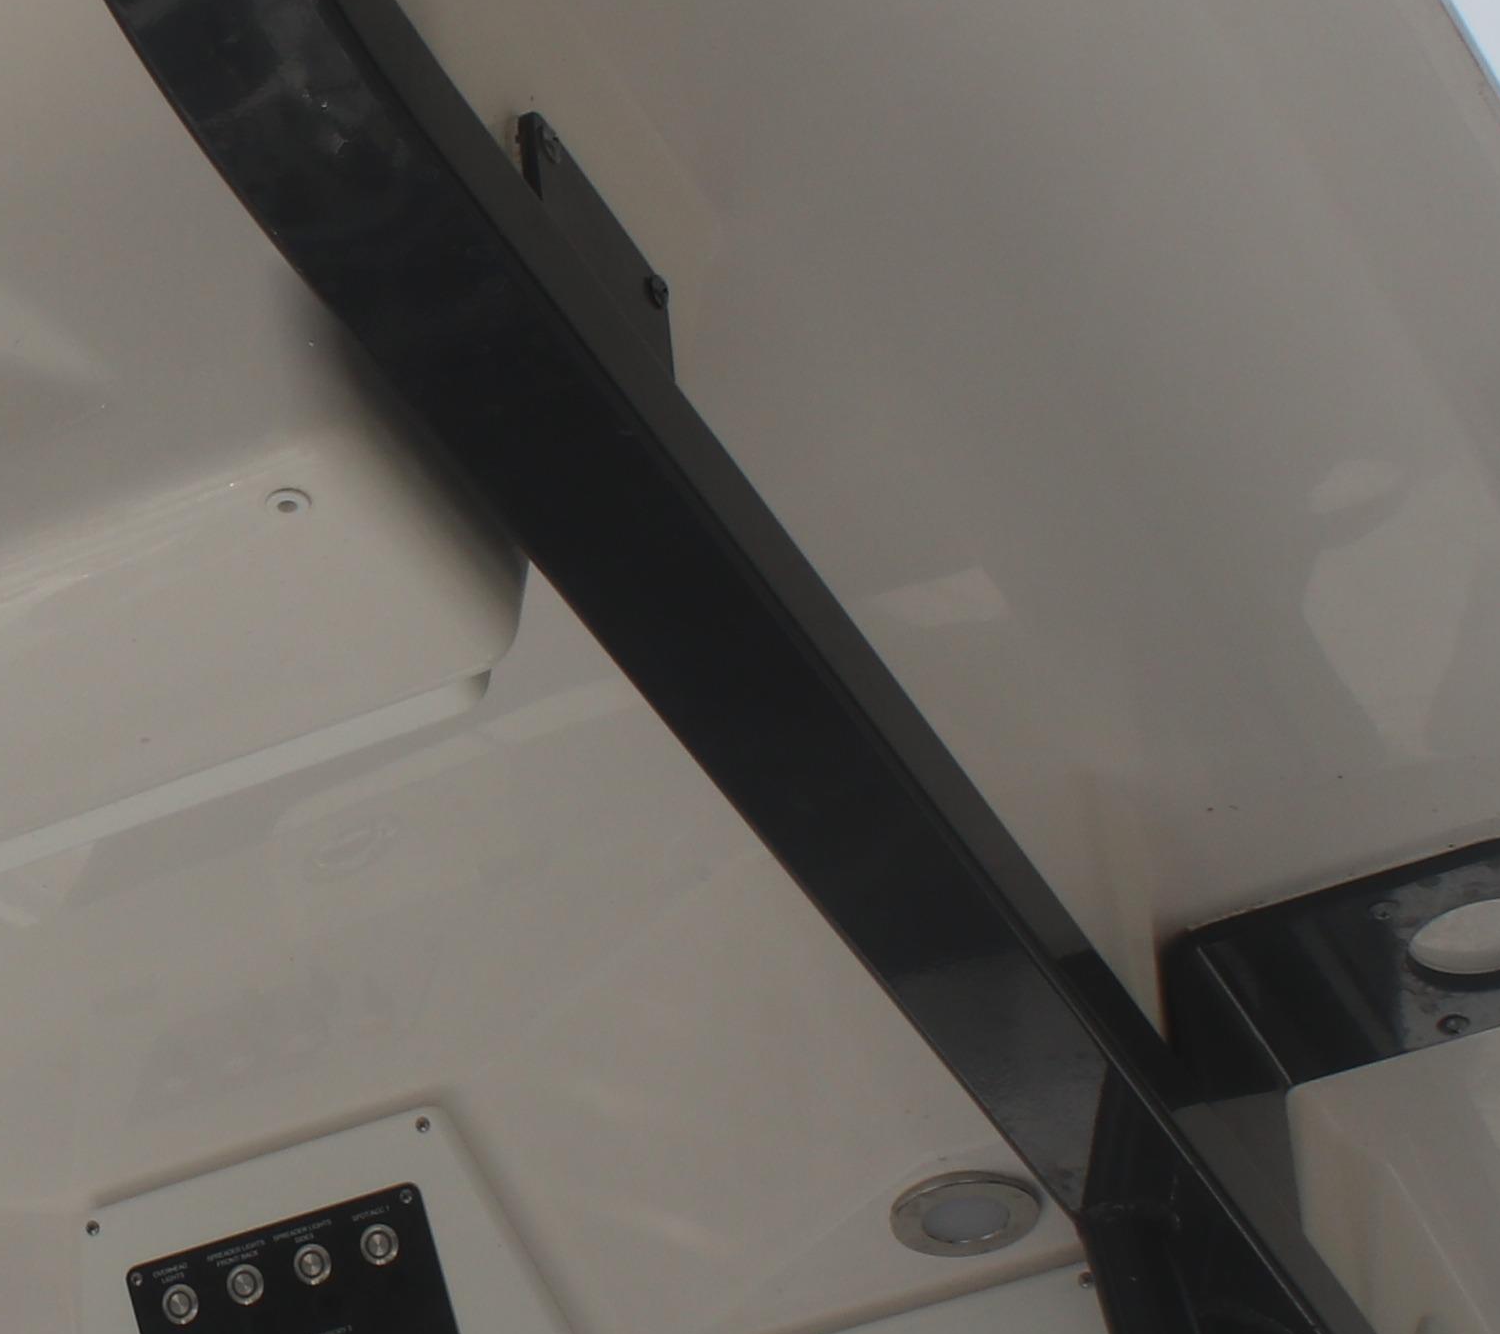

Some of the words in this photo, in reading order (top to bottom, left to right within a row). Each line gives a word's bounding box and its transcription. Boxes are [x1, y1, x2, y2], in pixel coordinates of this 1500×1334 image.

[308, 1219, 332, 1230] LIGHTS
[206, 1247, 240, 1262] SPREADER
[241, 1239, 265, 1251] LIGHTS
[152, 1262, 188, 1278] OVERHEAD
[161, 1272, 185, 1284] LIGHTS
